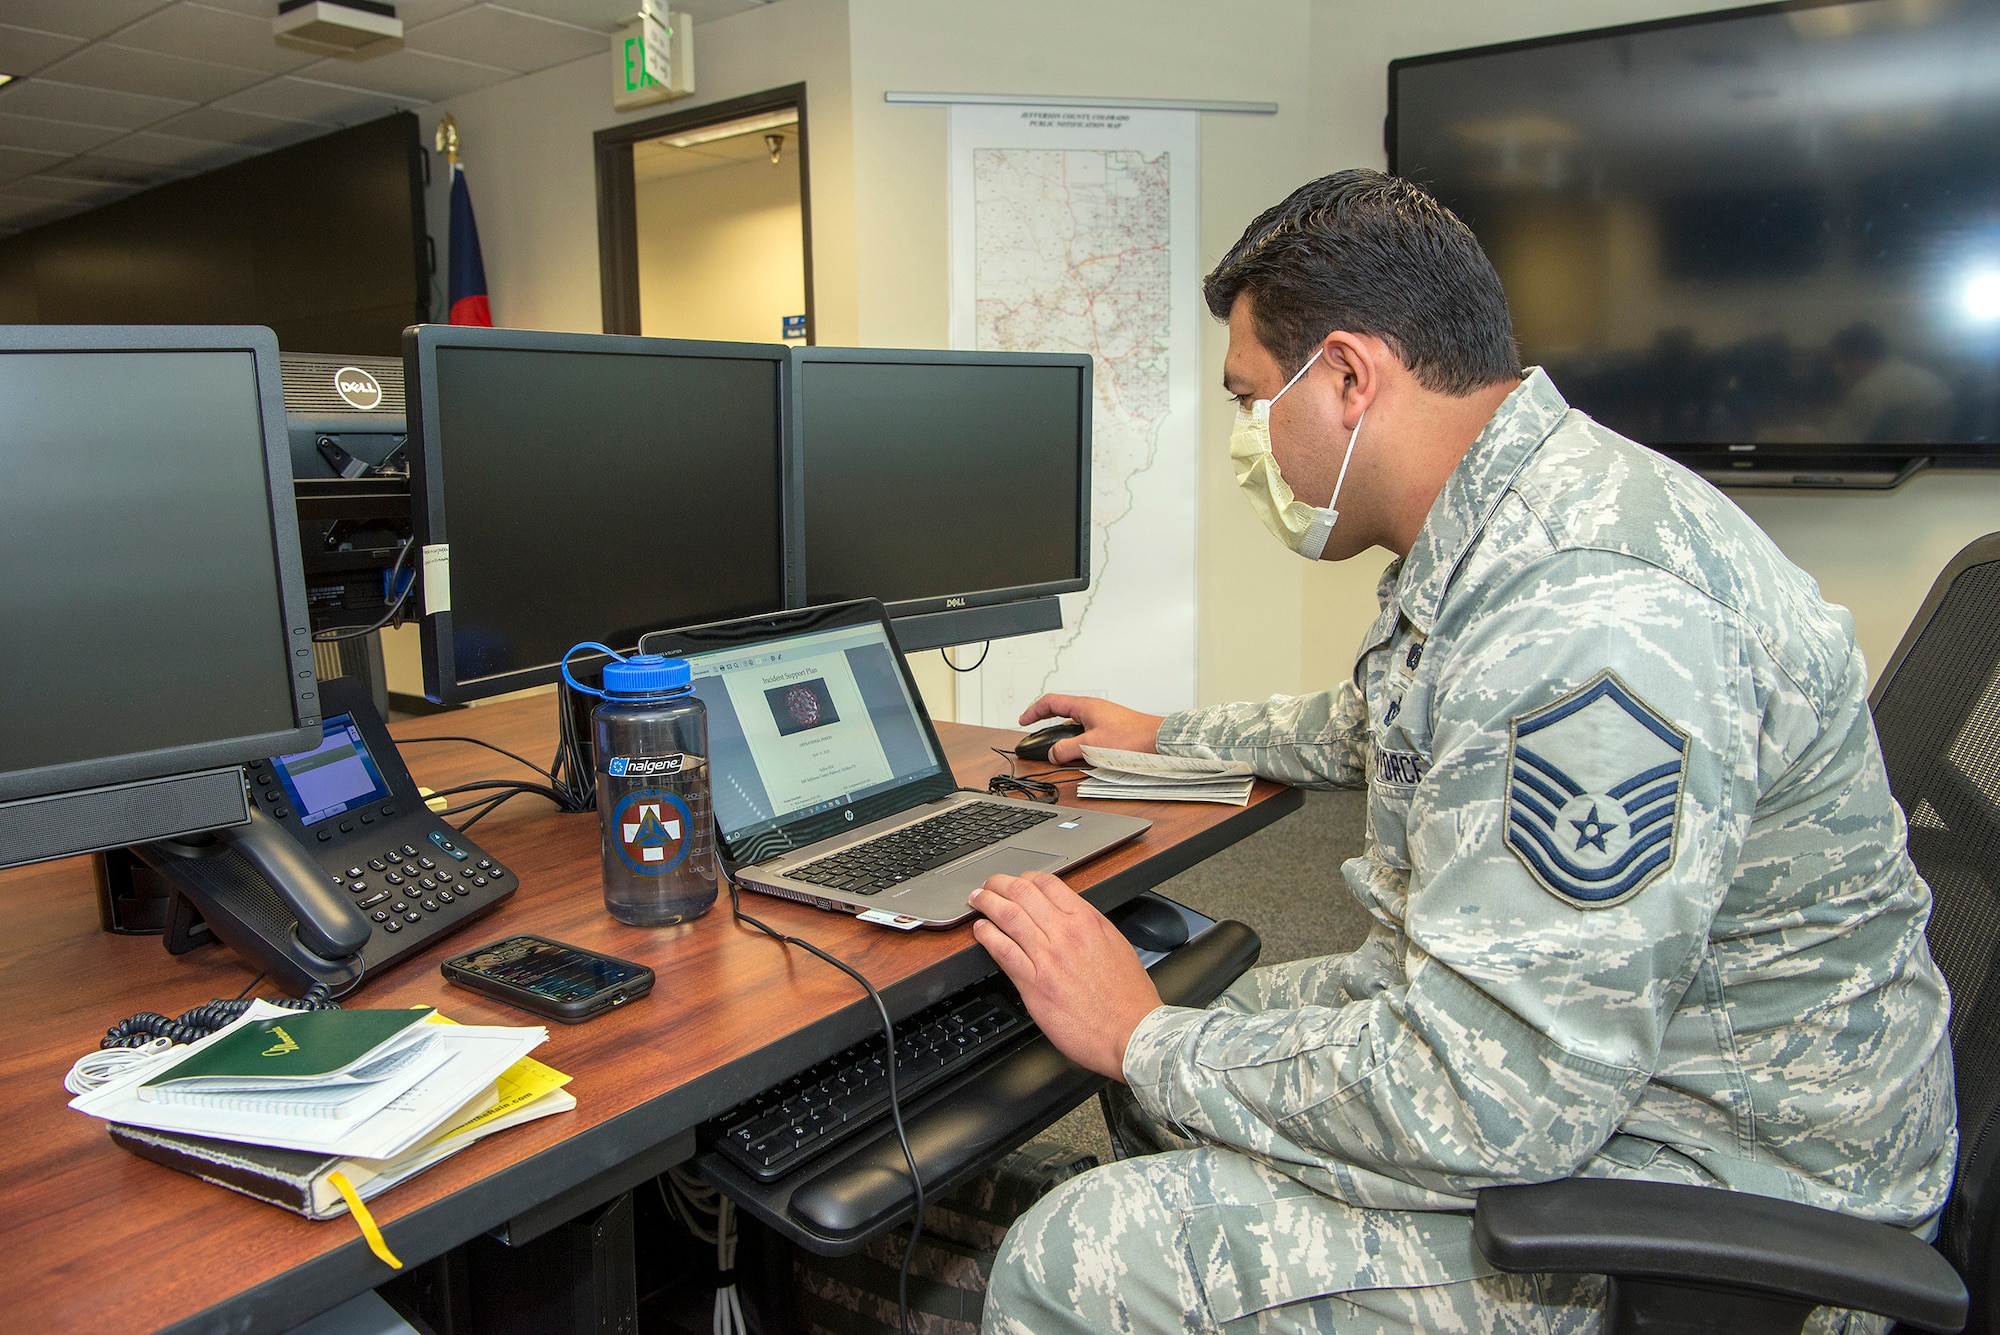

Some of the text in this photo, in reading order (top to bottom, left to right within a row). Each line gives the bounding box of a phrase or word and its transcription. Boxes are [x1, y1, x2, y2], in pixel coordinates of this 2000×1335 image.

[624, 36, 659, 91] EX
[1020, 112, 1060, 120] JEFFERSON
[1092, 113, 1131, 121] COLORADO
[1057, 120, 1105, 128] NOTIFICATION
[340, 381, 378, 394] DELL
[946, 597, 966, 608] DELL
[762, 667, 818, 684] Incident Support Plan
[628, 759, 679, 774] nalgene
